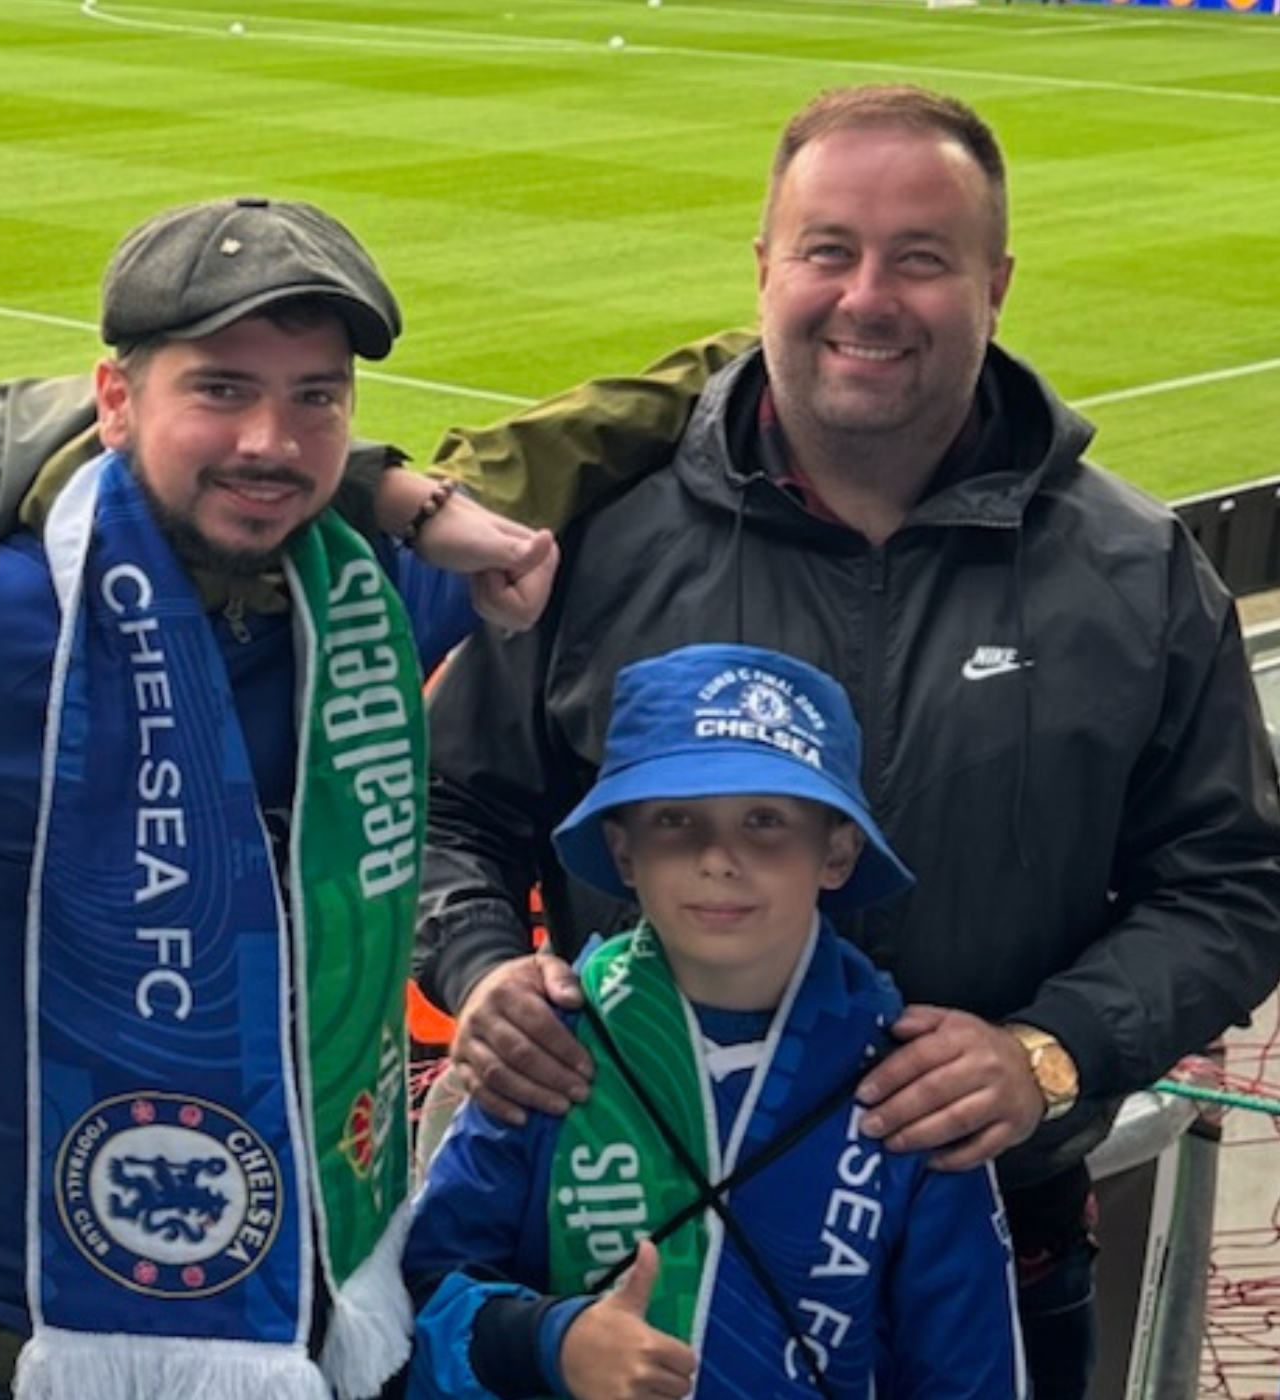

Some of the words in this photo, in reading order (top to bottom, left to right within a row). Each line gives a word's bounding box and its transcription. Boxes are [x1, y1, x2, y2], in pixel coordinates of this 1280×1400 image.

[322, 558, 409, 741] Betis
[973, 645, 1018, 665] NIKE
[101, 563, 190, 903] CHELSEA
[695, 718, 823, 769] CHELSEA
[332, 737, 416, 899] Real
[135, 927, 194, 1022] FC
[67, 1115, 109, 1203] FOOTBALL
[225, 1130, 274, 1263] CHELSEA
[73, 1208, 110, 1258] CLUB
